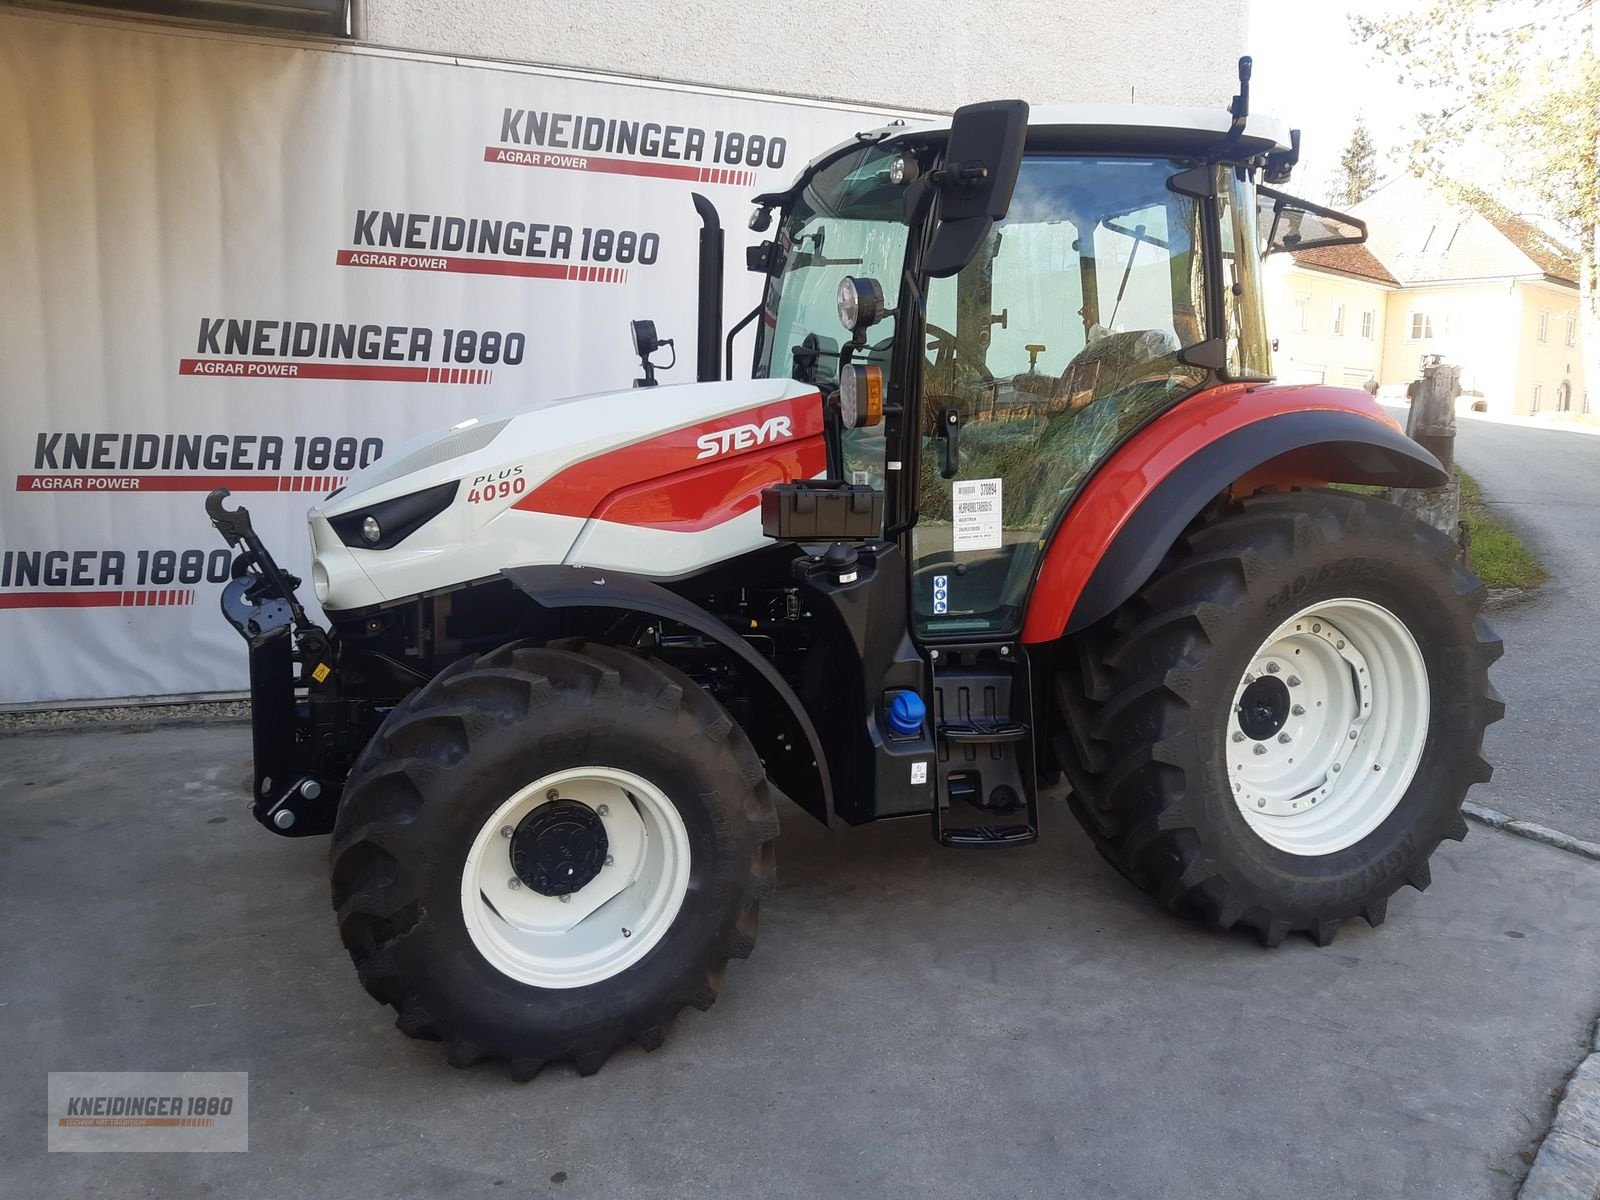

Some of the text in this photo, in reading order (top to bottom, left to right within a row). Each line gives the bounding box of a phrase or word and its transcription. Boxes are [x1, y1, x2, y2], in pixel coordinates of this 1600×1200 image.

[500, 107, 788, 170] KNEIDINGER 1880
[496, 150, 588, 169] AGRAR POWER
[353, 209, 660, 265] KNEIDINGER 1880
[349, 253, 448, 270] AGRAR POWER
[197, 317, 526, 366] KNEIDINGER 1880
[193, 362, 298, 376] AGRAR POWER
[33, 432, 384, 471] KNEIDINGER 1880
[696, 415, 793, 460] STEYR
[31, 478, 140, 489] AGRAR POWER
[467, 477, 526, 504] 4090
[473, 464, 524, 487] PLUS
[1, 549, 233, 587] INGER 1880
